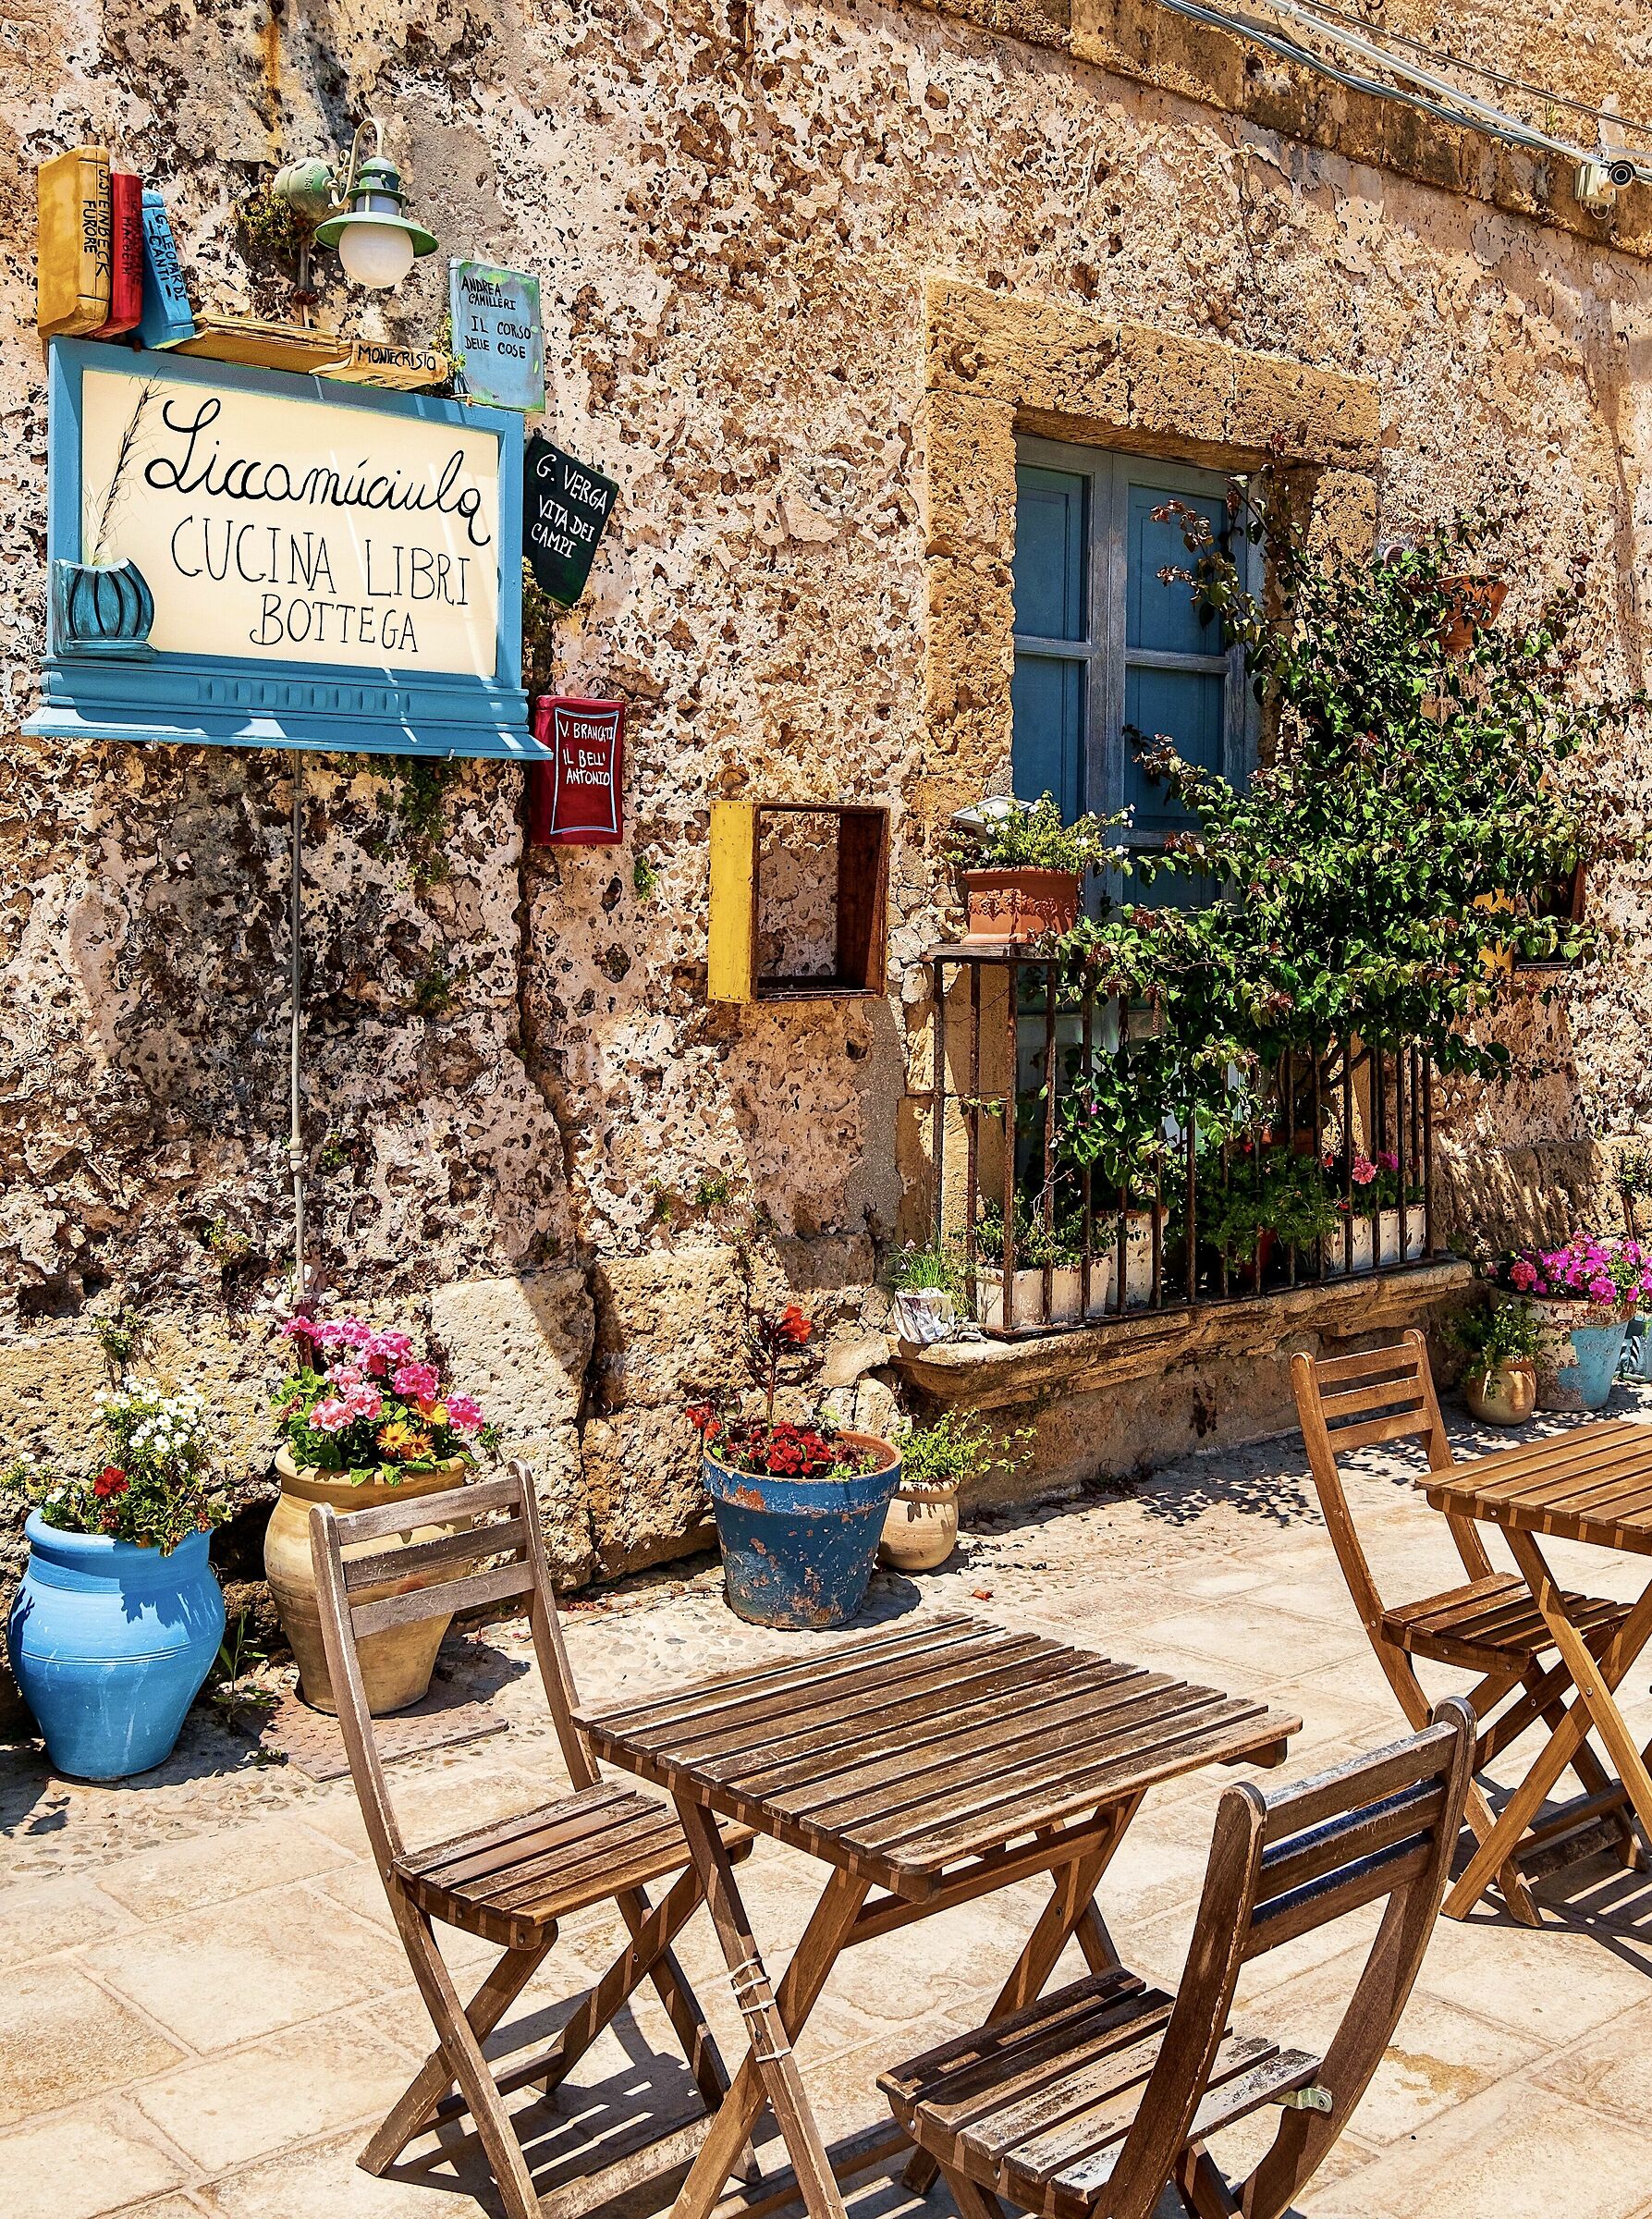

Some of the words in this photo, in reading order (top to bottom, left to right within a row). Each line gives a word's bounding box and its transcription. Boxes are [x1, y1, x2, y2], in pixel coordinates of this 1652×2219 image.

[82, 200, 98, 254] FURORE
[154, 214, 167, 229] G.
[161, 234, 188, 301] LEOPARDI
[460, 276, 502, 297] ANDREA
[468, 293, 517, 310] CAMILLERI
[471, 315, 489, 334] IL
[496, 322, 532, 339] CORSO
[357, 344, 436, 371] MONTECRISTO
[464, 335, 490, 351] DELLE
[496, 342, 526, 359] COSE
[536, 453, 557, 481] G.
[564, 464, 608, 515] VERGA
[539, 494, 569, 532] VITA
[569, 515, 595, 543] DEI
[531, 522, 578, 558] CAMPI
[171, 516, 337, 594] CUCINA
[365, 538, 471, 606] LIBRI
[250, 594, 420, 653] BOTTEGA
[558, 720, 569, 738] V.
[573, 722, 614, 742] BRANCATI
[563, 748, 574, 766] IL
[566, 767, 610, 786] ANTONIO
